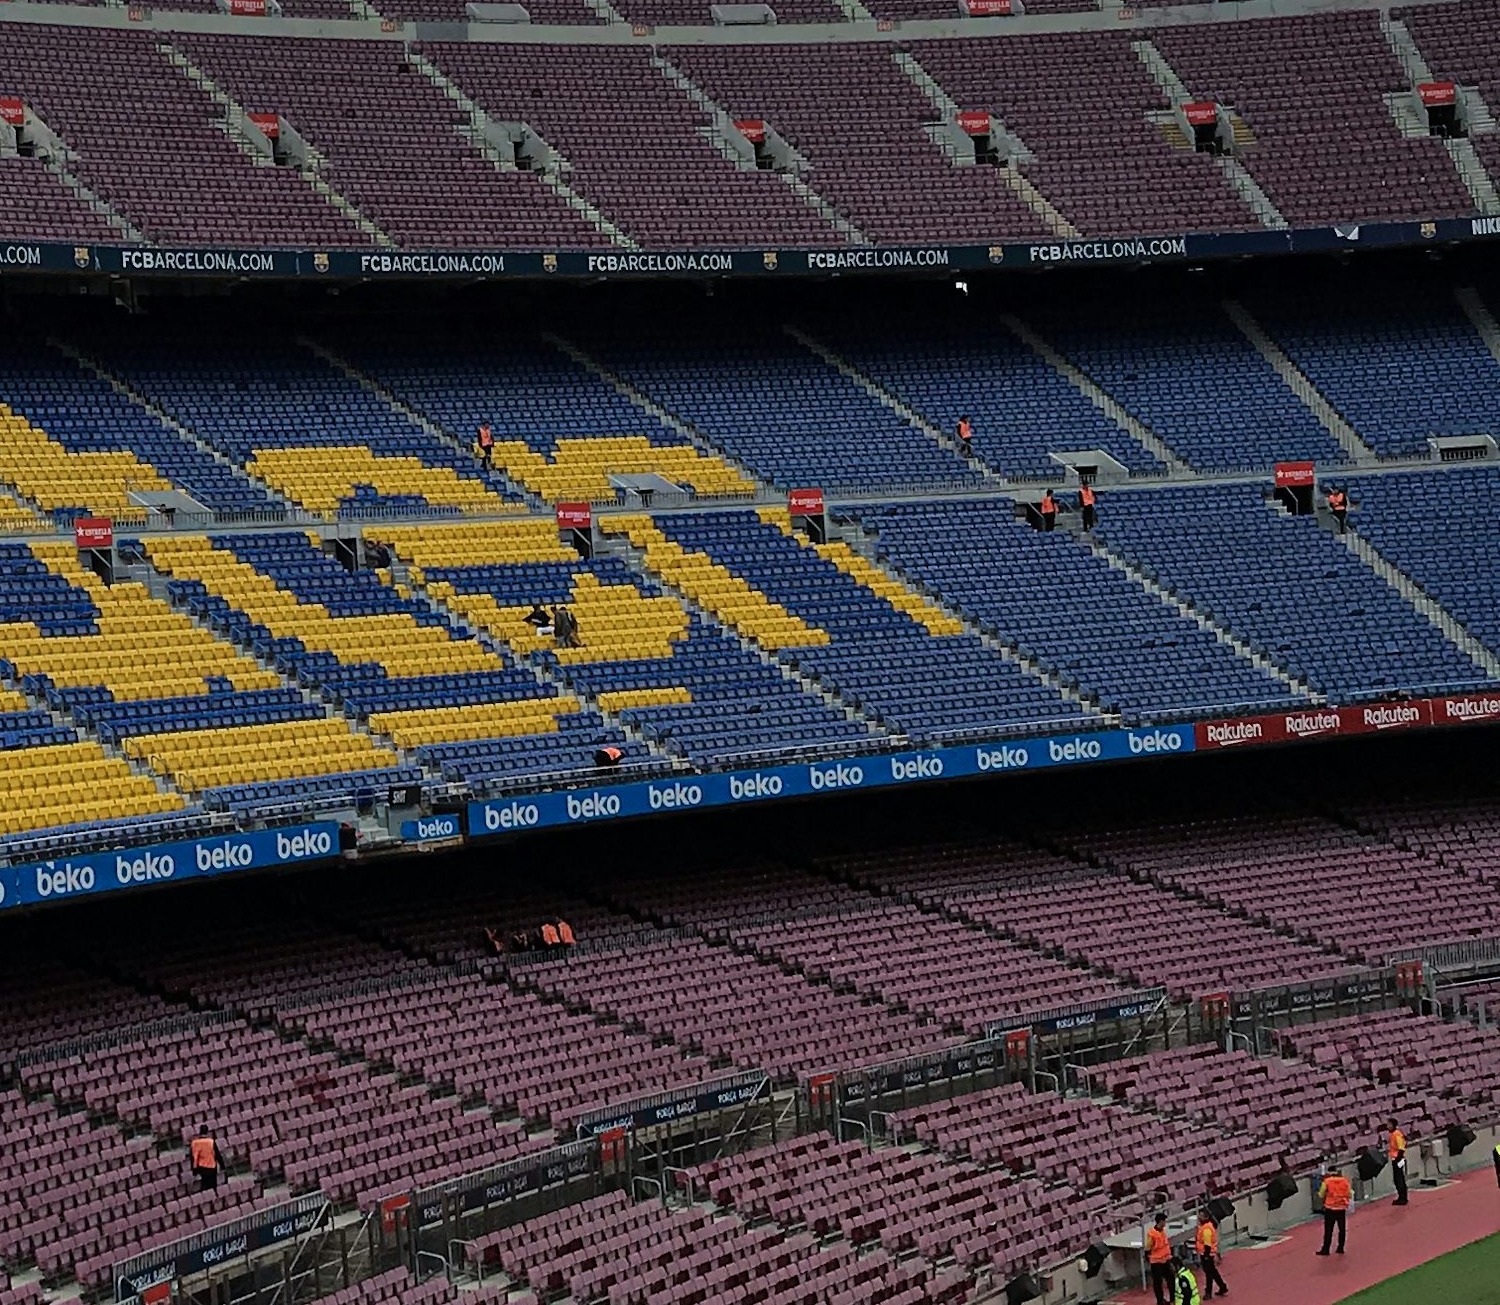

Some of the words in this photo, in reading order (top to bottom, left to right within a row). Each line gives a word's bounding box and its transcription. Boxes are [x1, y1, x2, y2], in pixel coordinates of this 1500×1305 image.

[122, 252, 274, 271] FCBARCELONA.COM
[807, 250, 949, 268] FCBARCELONA.COM
[1030, 239, 1187, 261] FCBARCELONA.COM
[361, 255, 505, 273] FCBARCELONA.COM
[588, 255, 733, 271] FCBARCELONA.COM
[1364, 703, 1420, 726] Rakuten
[1446, 697, 1500, 717] Rakute
[1207, 721, 1262, 743] Rakuten
[1285, 712, 1340, 734] Rakuten
[1049, 738, 1101, 762] beko
[1129, 730, 1182, 753] beko
[891, 754, 943, 780] beko
[977, 746, 1028, 771] beko
[730, 773, 783, 799] beko
[810, 763, 863, 789] beko
[567, 792, 621, 819] beko
[649, 783, 702, 809] beko
[485, 802, 539, 829] beko
[418, 819, 453, 838] beko
[196, 841, 252, 871] beko
[277, 829, 331, 859] beko
[37, 863, 95, 896] beko
[116, 852, 174, 883] beko
